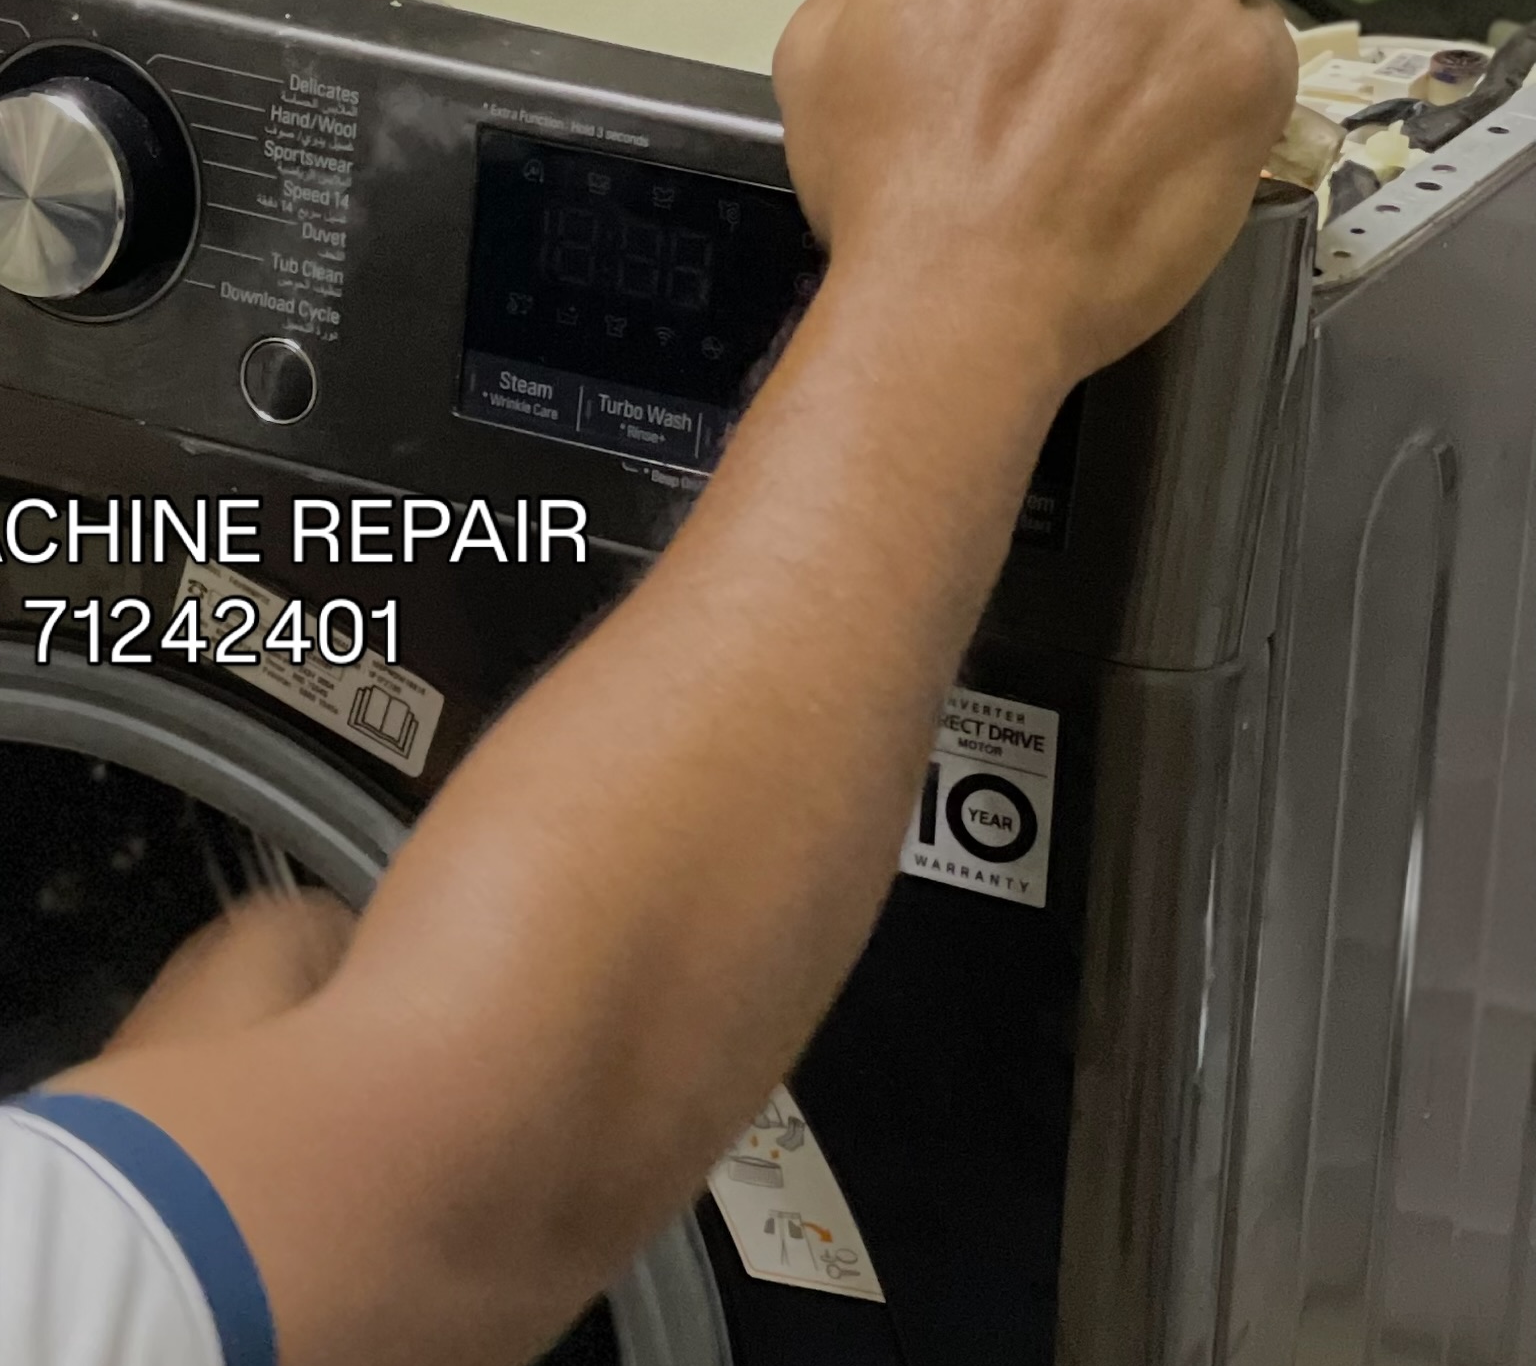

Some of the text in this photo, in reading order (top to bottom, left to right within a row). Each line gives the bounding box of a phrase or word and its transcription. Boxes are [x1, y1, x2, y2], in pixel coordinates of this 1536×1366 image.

[289, 73, 360, 105] Delicates
[270, 104, 357, 140] Hand/Wool
[605, 129, 650, 148] seconds
[264, 139, 354, 174] Sportswear
[283, 179, 350, 210] Speed 14
[301, 222, 347, 248] Duvet
[271, 251, 299, 275] Tub
[301, 259, 344, 284] Clean
[220, 281, 340, 325] Download Cycle
[490, 392, 559, 421] Wrinkle Care
[498, 370, 692, 432] Steam Turbo Wash
[957, 737, 1003, 757] MOTOR
[989, 724, 1045, 753] DRIVE
[968, 807, 1014, 832] YEAR
[914, 853, 1029, 894] WARRANTY
